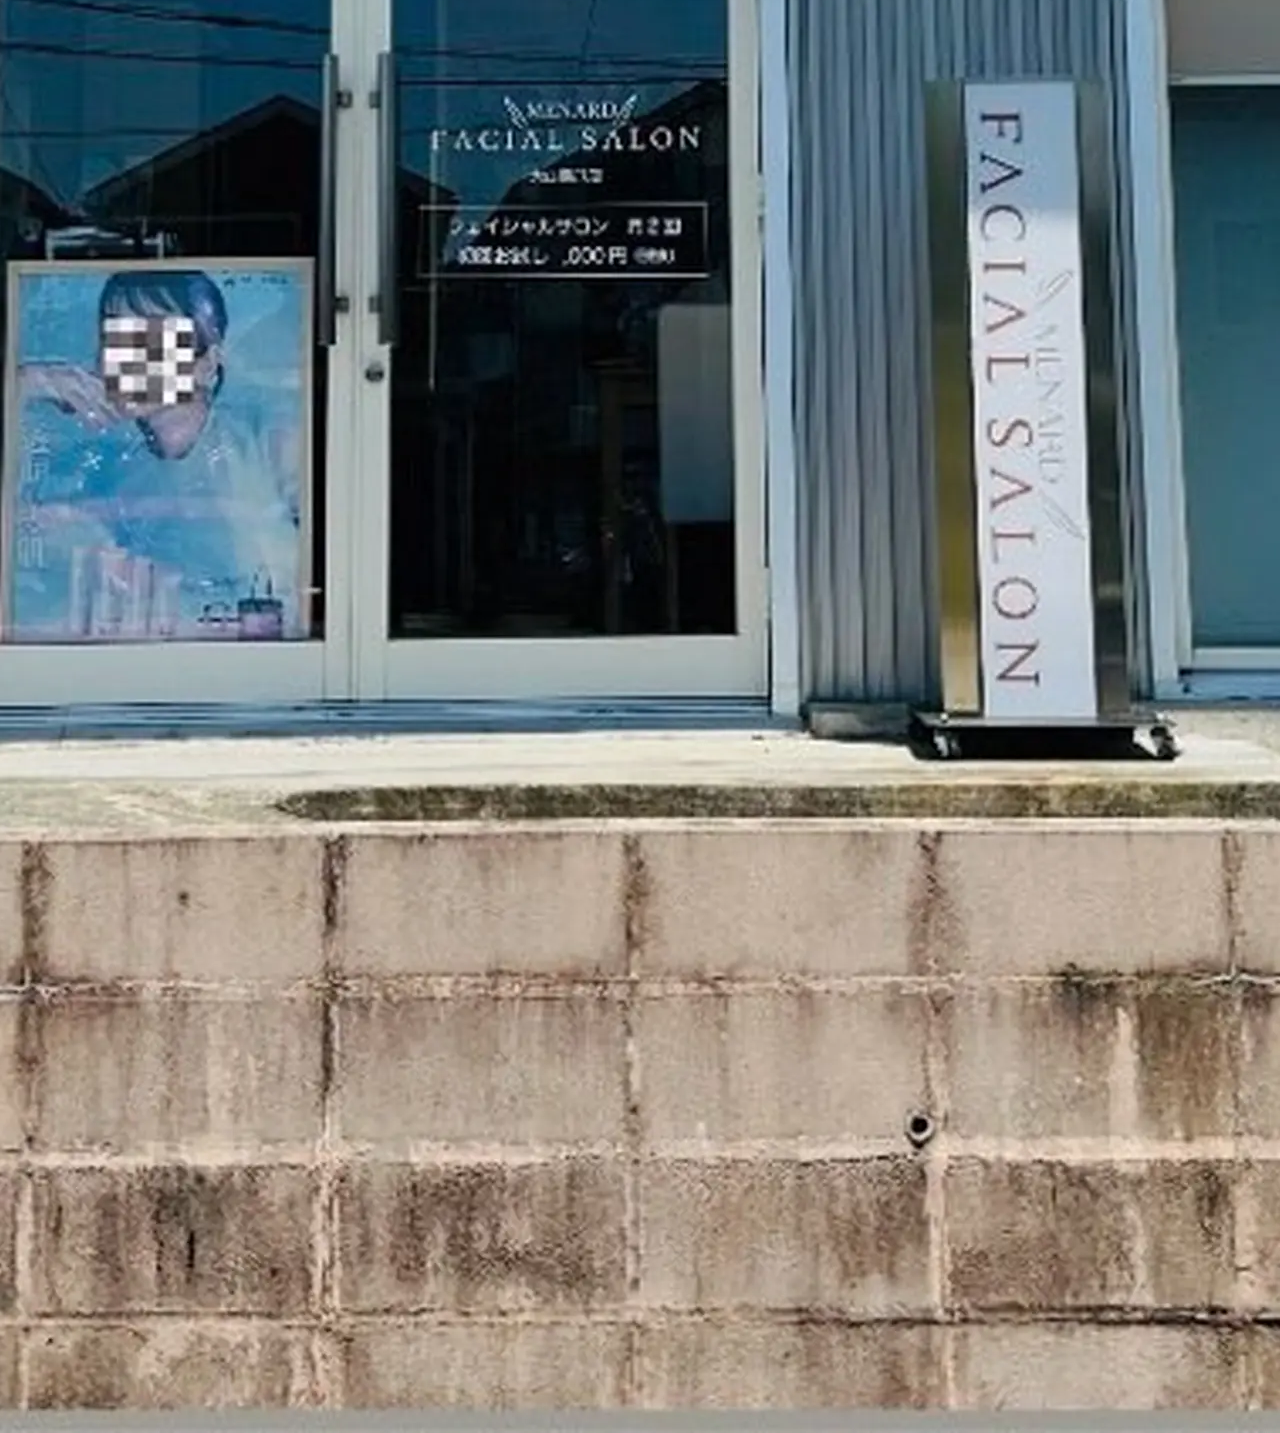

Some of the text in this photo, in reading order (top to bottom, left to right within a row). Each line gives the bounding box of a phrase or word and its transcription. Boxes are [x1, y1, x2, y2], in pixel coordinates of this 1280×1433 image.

[527, 102, 615, 120] MENARD
[431, 126, 701, 151] FACIAL SALON
[978, 111, 1042, 688] FACIAL SALON
